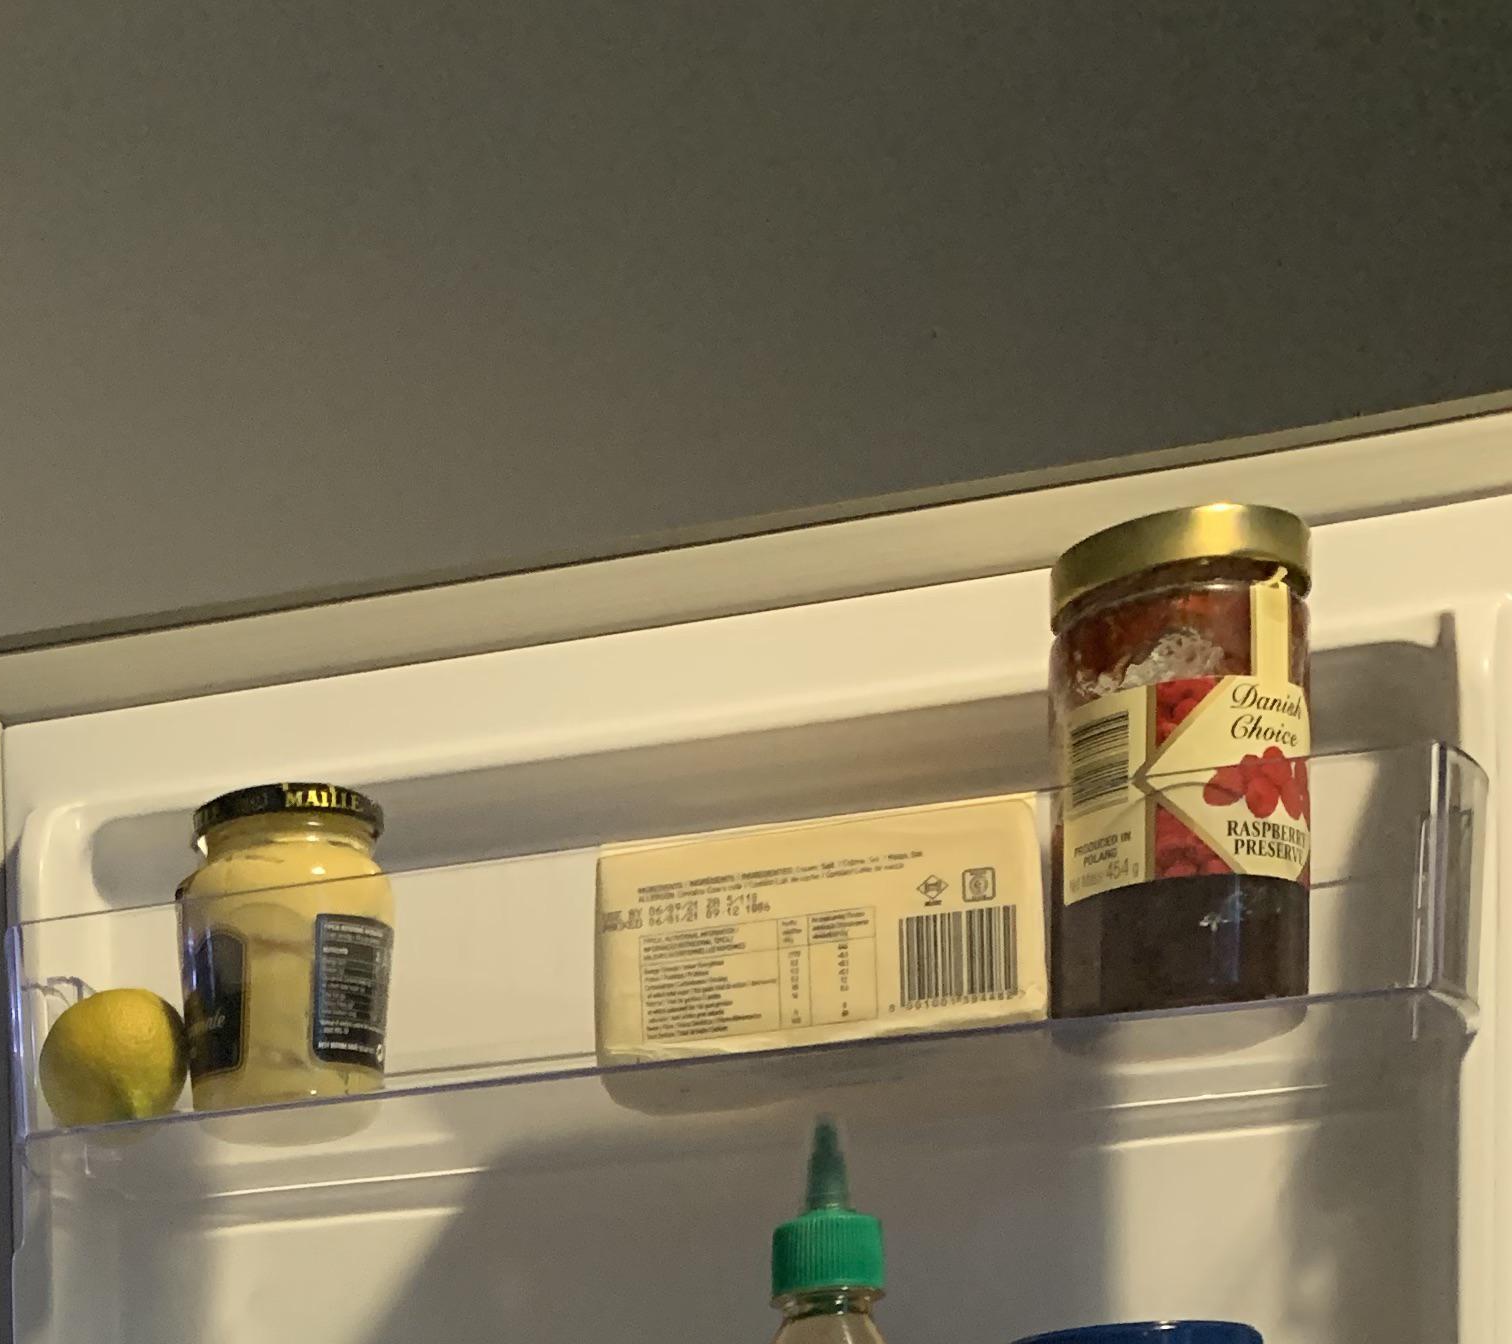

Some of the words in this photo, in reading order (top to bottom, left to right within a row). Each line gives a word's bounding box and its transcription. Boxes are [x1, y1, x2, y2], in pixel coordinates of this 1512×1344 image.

[1230, 683, 1302, 720] Danish
[1230, 714, 1299, 748] Choice
[285, 789, 364, 812] MAILLE
